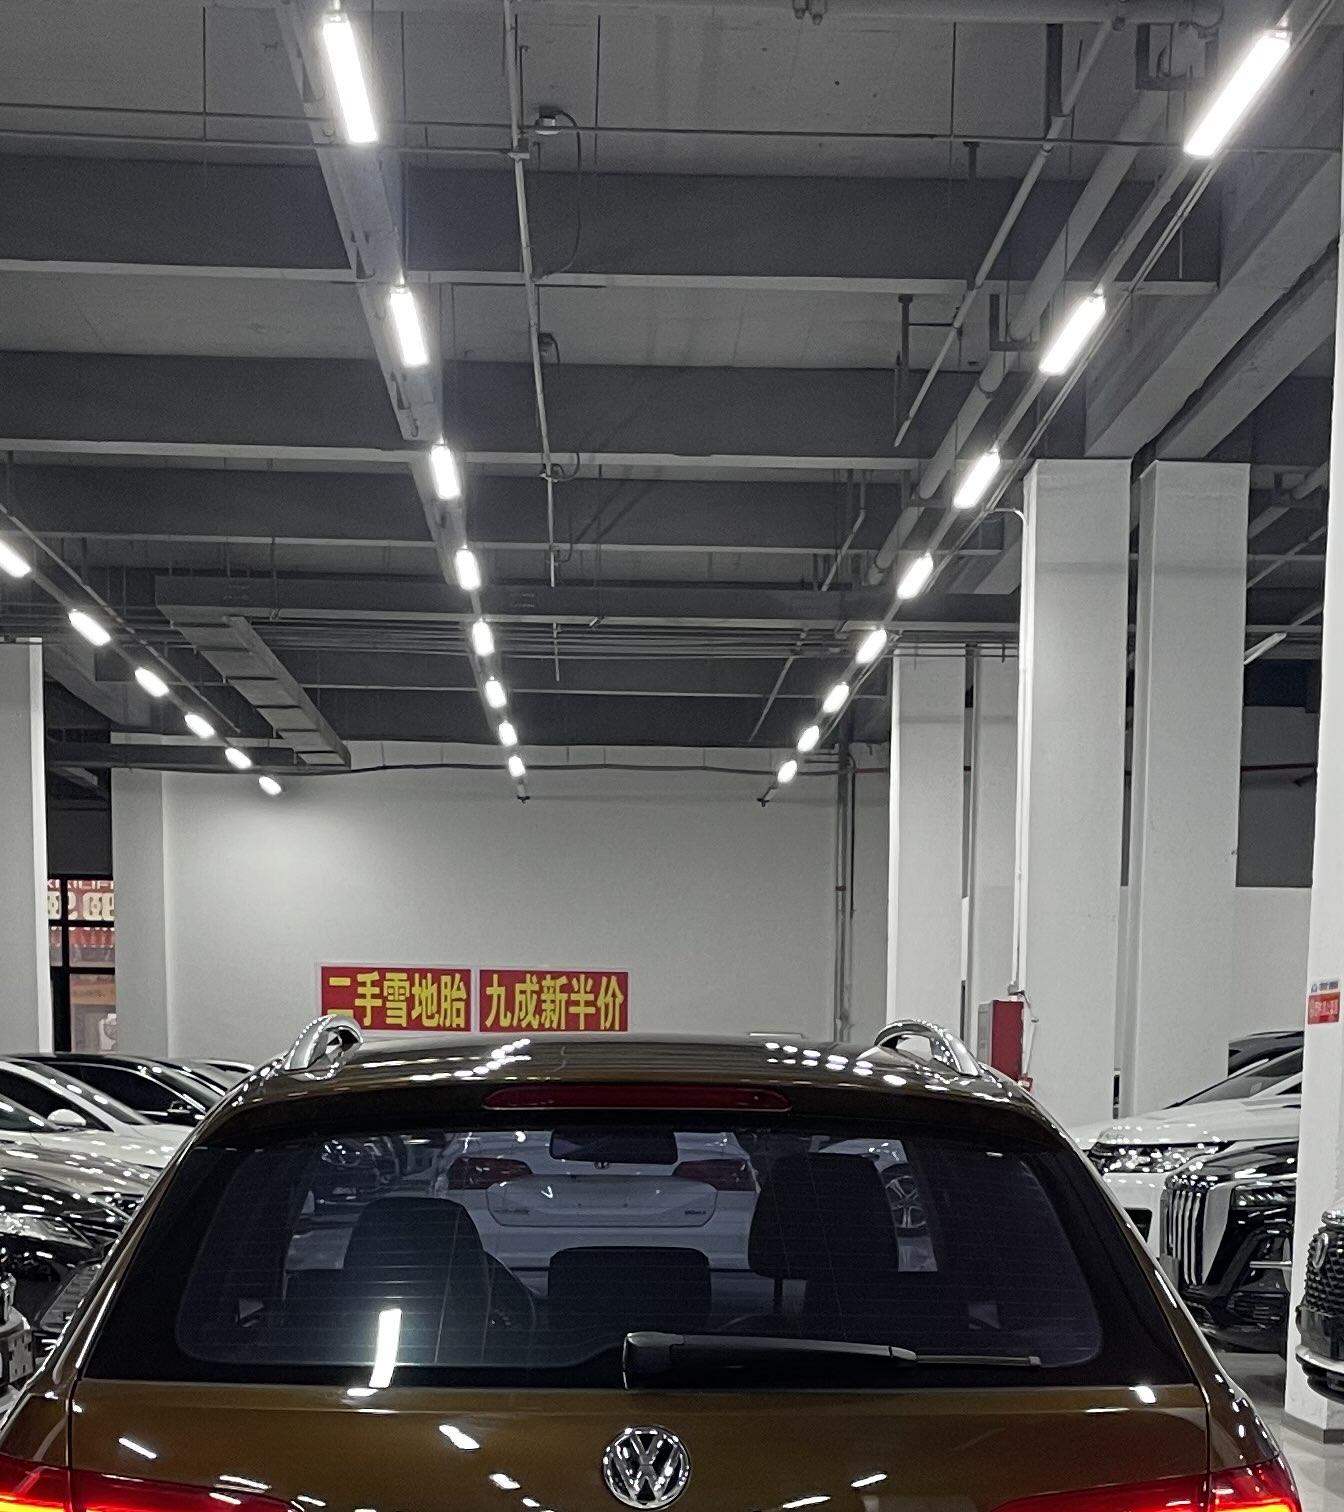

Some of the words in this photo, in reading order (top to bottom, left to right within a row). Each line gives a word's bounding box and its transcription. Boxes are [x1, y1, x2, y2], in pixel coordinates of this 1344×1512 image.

[327, 971, 467, 1029] 二手雪地胎
[485, 973, 624, 1031] 九成新半价
